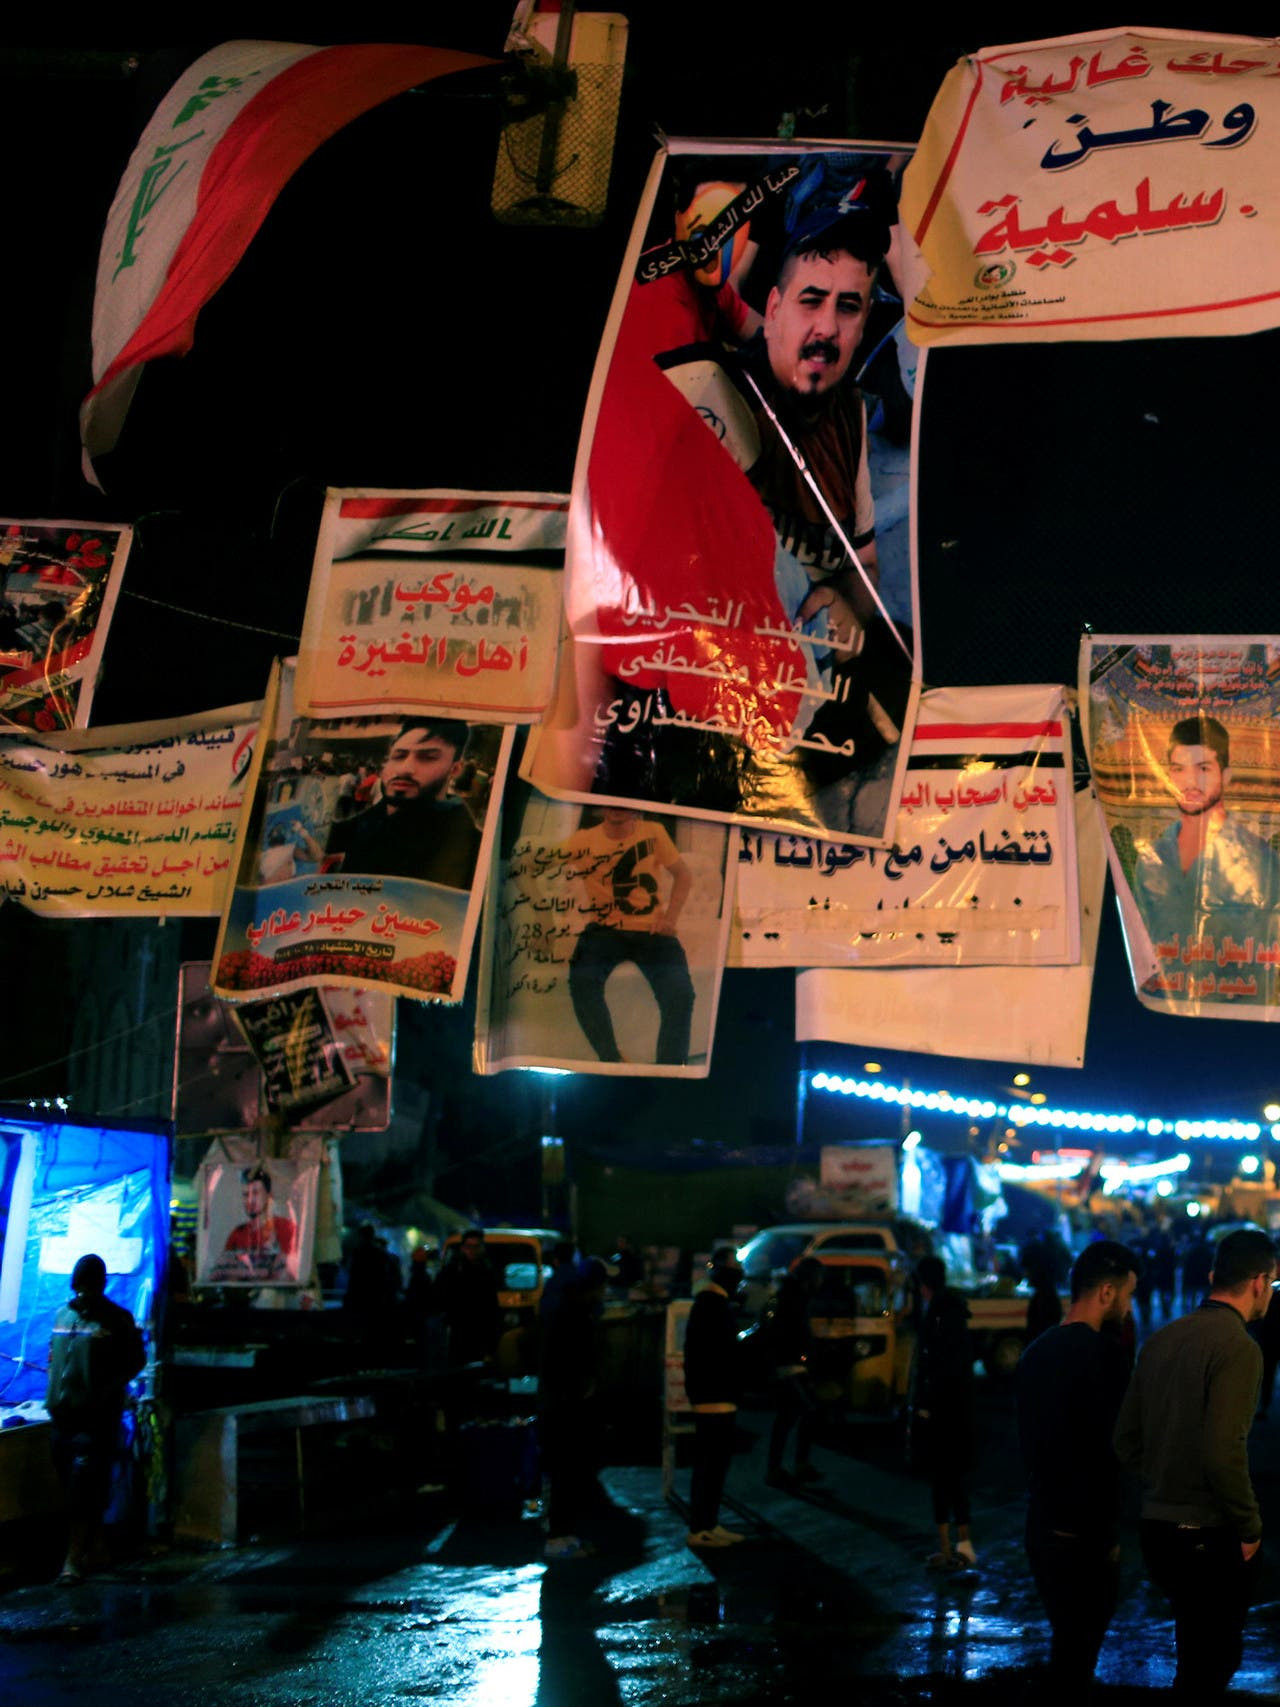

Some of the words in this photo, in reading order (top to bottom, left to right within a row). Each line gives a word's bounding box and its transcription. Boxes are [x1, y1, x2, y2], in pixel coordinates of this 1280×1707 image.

[1000, 46, 1150, 106] غالية
[1040, 99, 1257, 172] وطن
[973, 176, 1228, 268] سلمية
[395, 572, 495, 613] موكب
[337, 632, 446, 677] الغيرة
[456, 634, 529, 677] أهل
[619, 644, 749, 684] مصطفى
[187, 725, 236, 751] قبيلة
[934, 780, 1008, 812] اصحاب
[1013, 780, 1058, 812] نحن
[30, 850, 91, 870] مطالب
[93, 855, 148, 879] تحقيق
[203, 855, 230, 877] من
[883, 843, 922, 881] مع
[930, 829, 1054, 874] نتضامن
[31, 881, 82, 901] حسون
[137, 884, 192, 902] الشيخ
[301, 902, 367, 933] حيدر
[371, 904, 442, 939] حسين
